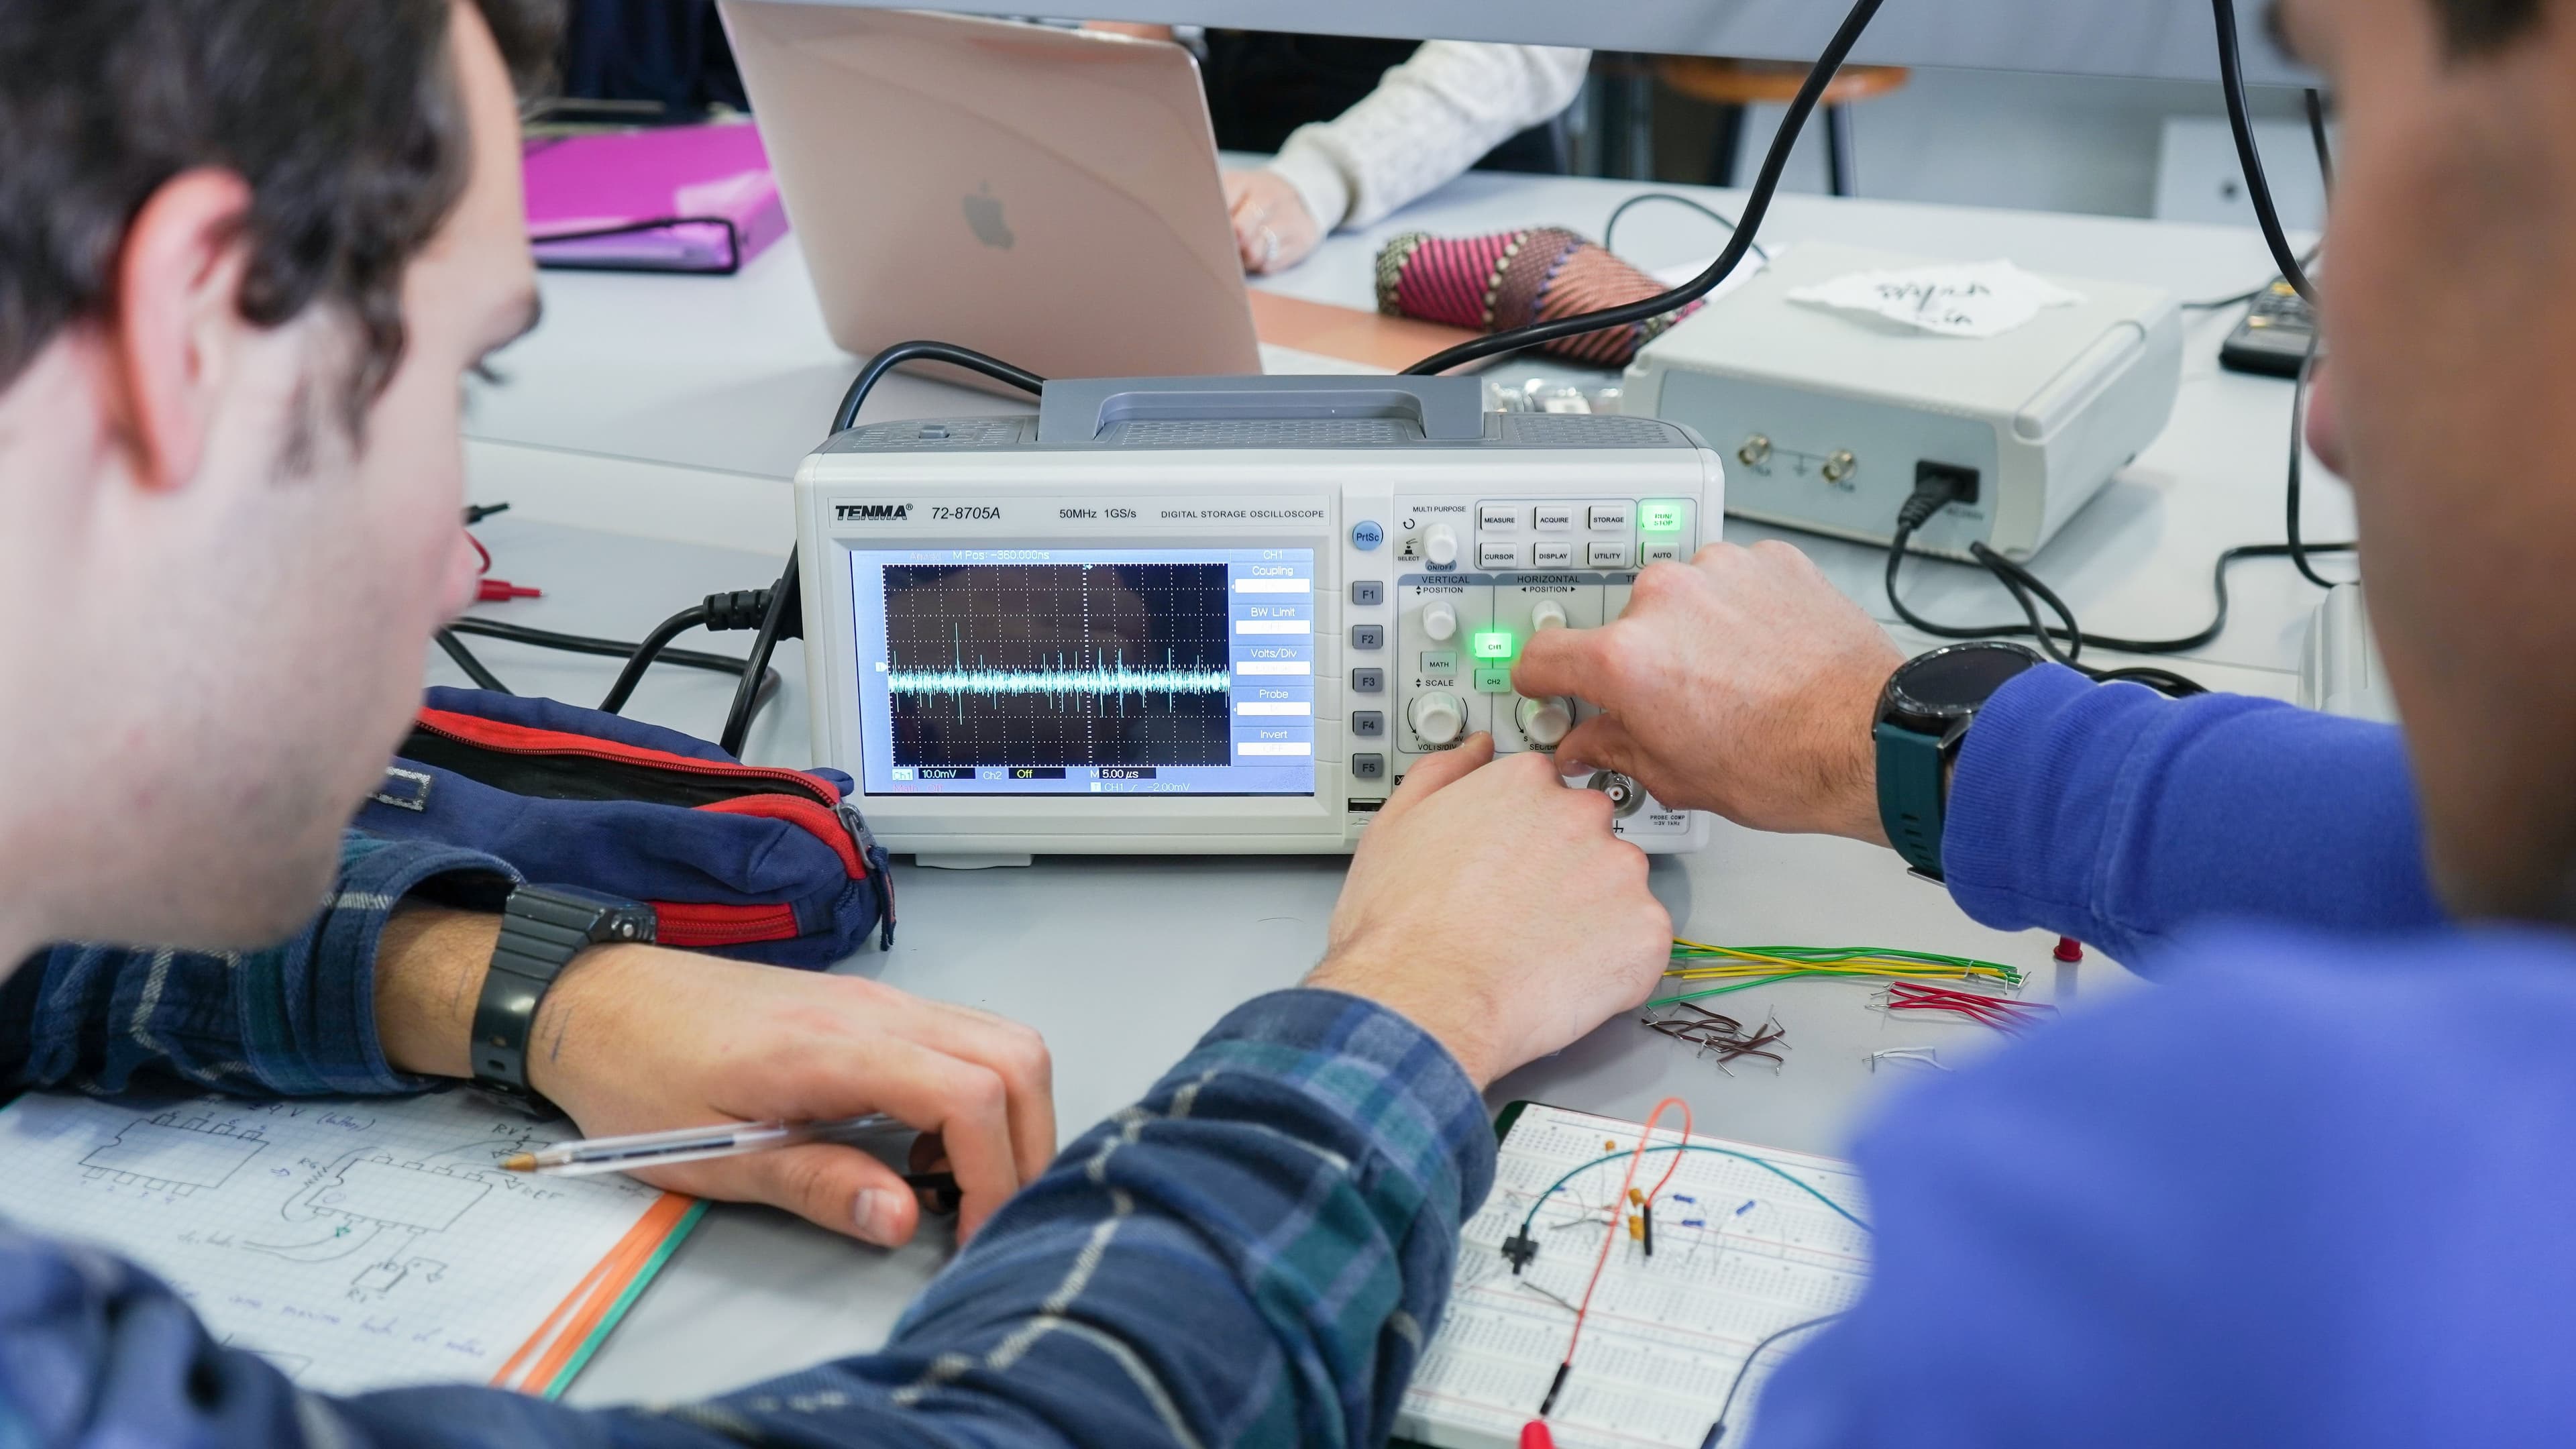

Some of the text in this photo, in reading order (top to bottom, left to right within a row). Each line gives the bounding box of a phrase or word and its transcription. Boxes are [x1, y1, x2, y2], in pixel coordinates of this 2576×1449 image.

[932, 507, 1001, 520] 72-8705A
[1059, 508, 1137, 519] 50MHz 1GS/s
[1161, 510, 1324, 519] DIGITAL STORAGE OSCILLOSCOPE
[1356, 533, 1379, 542] PrtSc
[953, 550, 963, 559] M
[1263, 550, 1283, 559] CH1
[1252, 566, 1294, 576] Coupling
[1421, 576, 1470, 584] VERTICAL
[1362, 590, 1374, 599] F1
[1250, 607, 1295, 617] BW Limit
[1362, 635, 1373, 643] F2
[1250, 648, 1297, 658] Volts/Div
[1362, 678, 1375, 686] F3
[1259, 690, 1289, 698] Probe
[1362, 721, 1375, 730] F4
[1260, 730, 1288, 739] Invert
[1362, 763, 1375, 772] F5
[922, 769, 957, 779] 10.0mV
[983, 769, 1033, 780] Ch2 Off
[1090, 769, 1099, 778] M
[1102, 769, 1124, 778] 5.00
[1105, 783, 1124, 791] CH1
